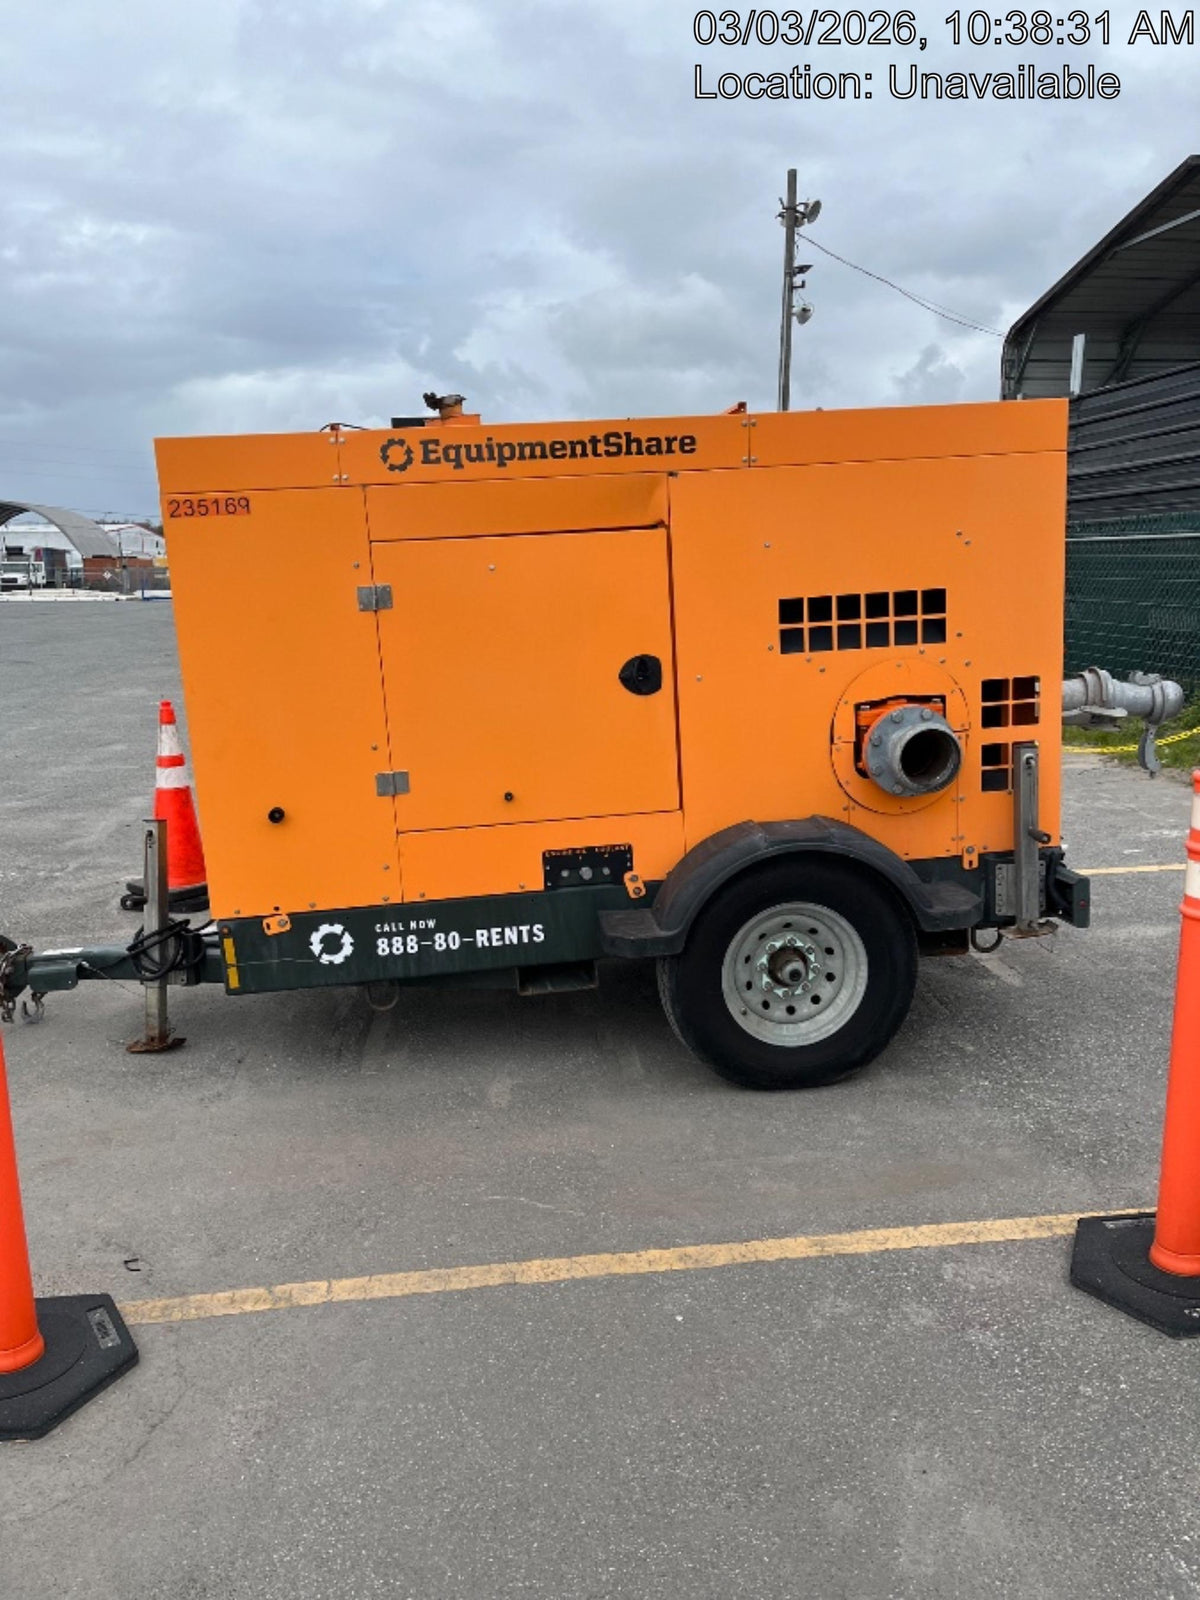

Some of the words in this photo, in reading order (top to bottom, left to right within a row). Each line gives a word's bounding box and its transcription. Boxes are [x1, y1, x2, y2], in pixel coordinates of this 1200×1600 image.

[420, 431, 696, 470] EquipmentShare
[168, 497, 250, 518] 235169
[375, 921, 405, 933] CALL
[410, 919, 436, 931] NOW
[375, 924, 545, 956] 888-80-RENTS
